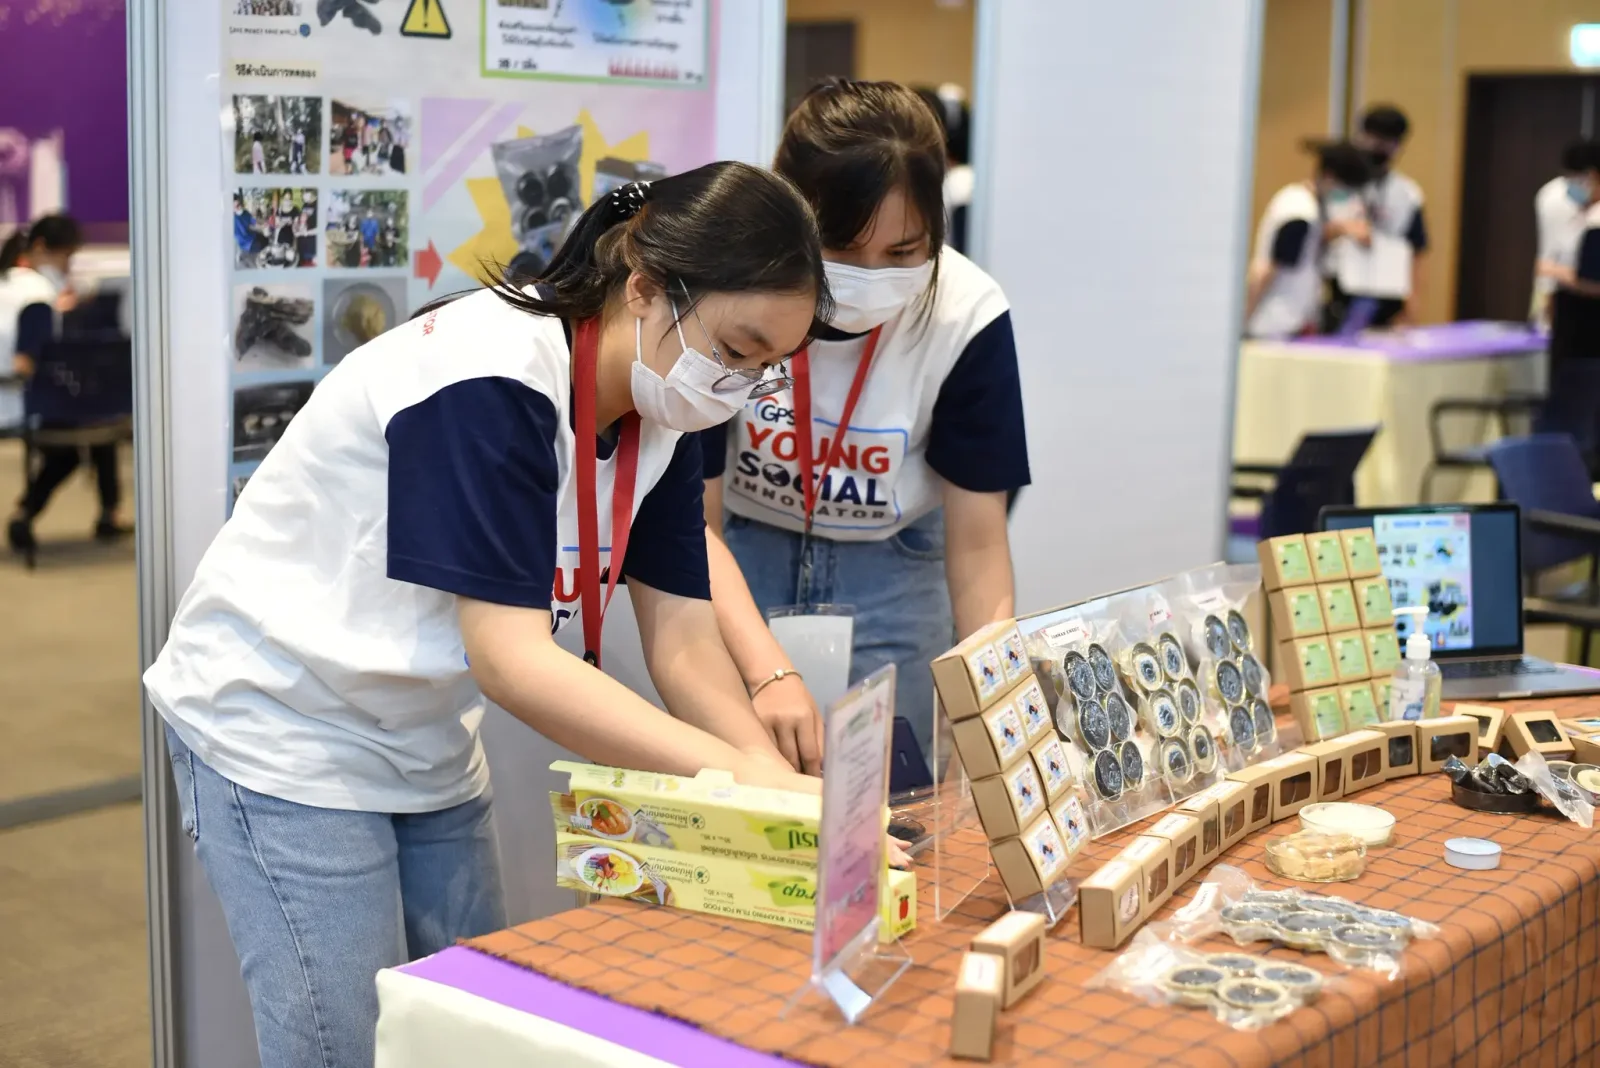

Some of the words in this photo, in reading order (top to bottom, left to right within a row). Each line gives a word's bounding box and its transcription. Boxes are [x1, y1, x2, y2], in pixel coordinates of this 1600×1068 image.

[760, 404, 796, 426] GPS
[746, 421, 890, 474] YOUNG
[736, 450, 888, 506] SOCIAL
[782, 885, 816, 901] rap
[703, 902, 721, 911] FOOD
